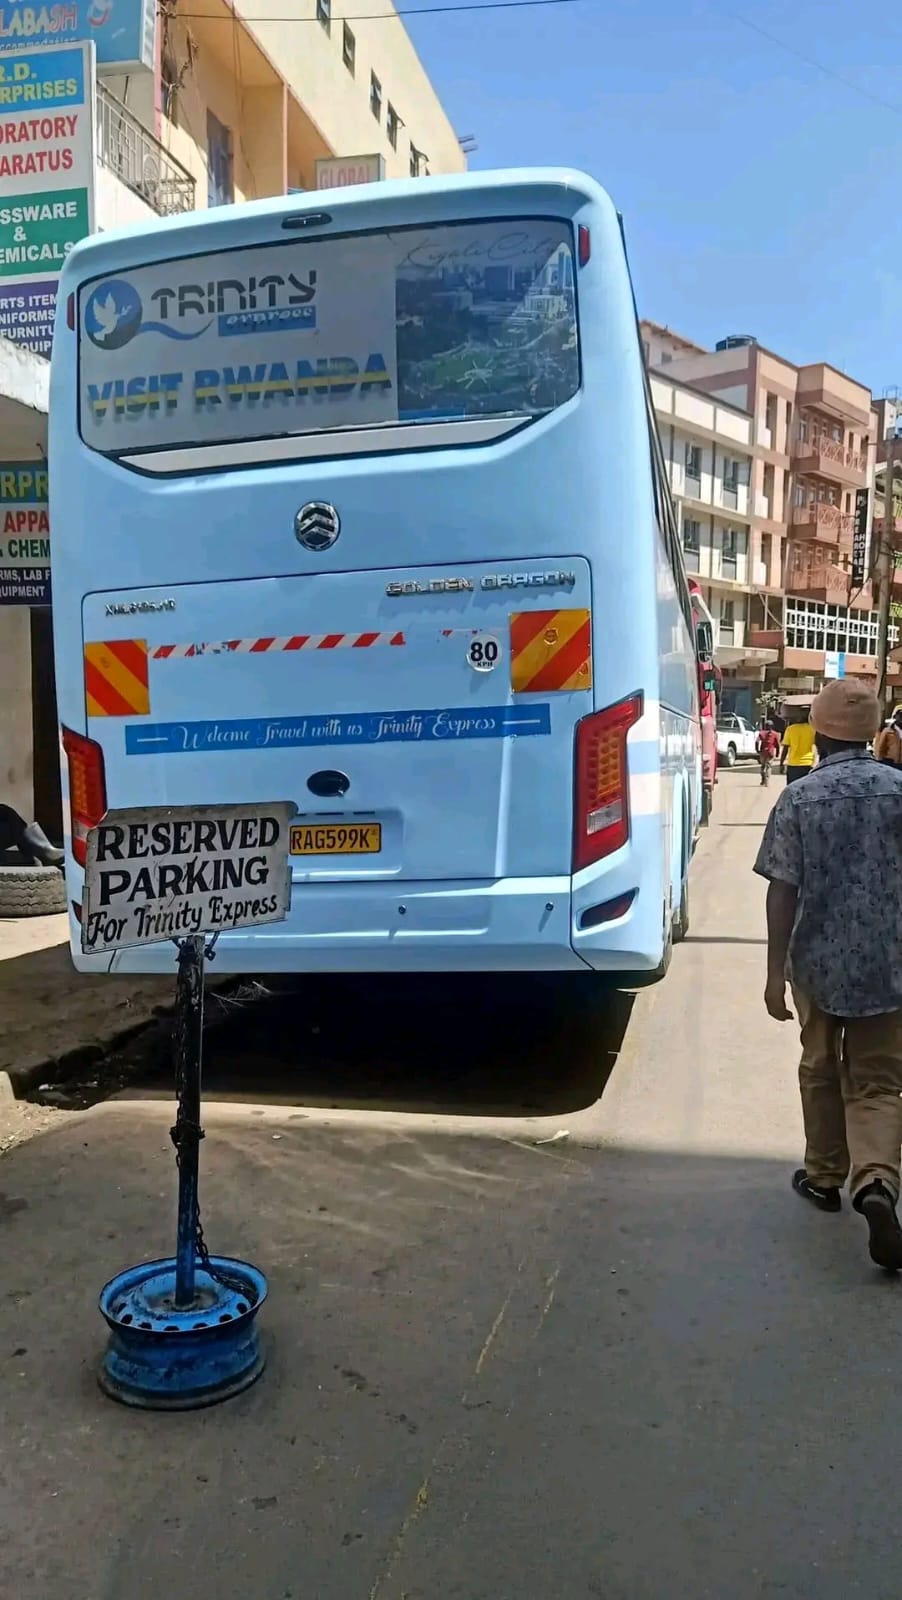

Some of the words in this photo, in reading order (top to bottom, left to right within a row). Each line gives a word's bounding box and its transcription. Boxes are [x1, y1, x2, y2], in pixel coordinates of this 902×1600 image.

[0, 79, 78, 104] RPRISES
[13, 226, 27, 242] &
[151, 270, 317, 319] TRINITY
[87, 372, 183, 417] VISIT
[194, 353, 392, 405] RWANDA
[857, 533, 866, 575] HOTEL
[0, 585, 45, 598] UIPMENT
[23, 569, 42, 581] LAB
[385, 576, 475, 597] GOLDEN
[480, 569, 576, 591] DRAGON
[470, 641, 498, 662] 80
[172, 725, 250, 750] Welcome
[256, 720, 308, 745] Travel
[311, 718, 341, 738] with
[346, 724, 363, 736] us
[368, 714, 424, 741] Trinity
[426, 711, 496, 738] Express
[95, 816, 280, 862] RESERVED
[291, 828, 370, 851] RAG599K
[98, 855, 270, 906] PARKING
[86, 910, 128, 945] For
[133, 899, 203, 938] Trinity
[208, 893, 278, 926] Express
